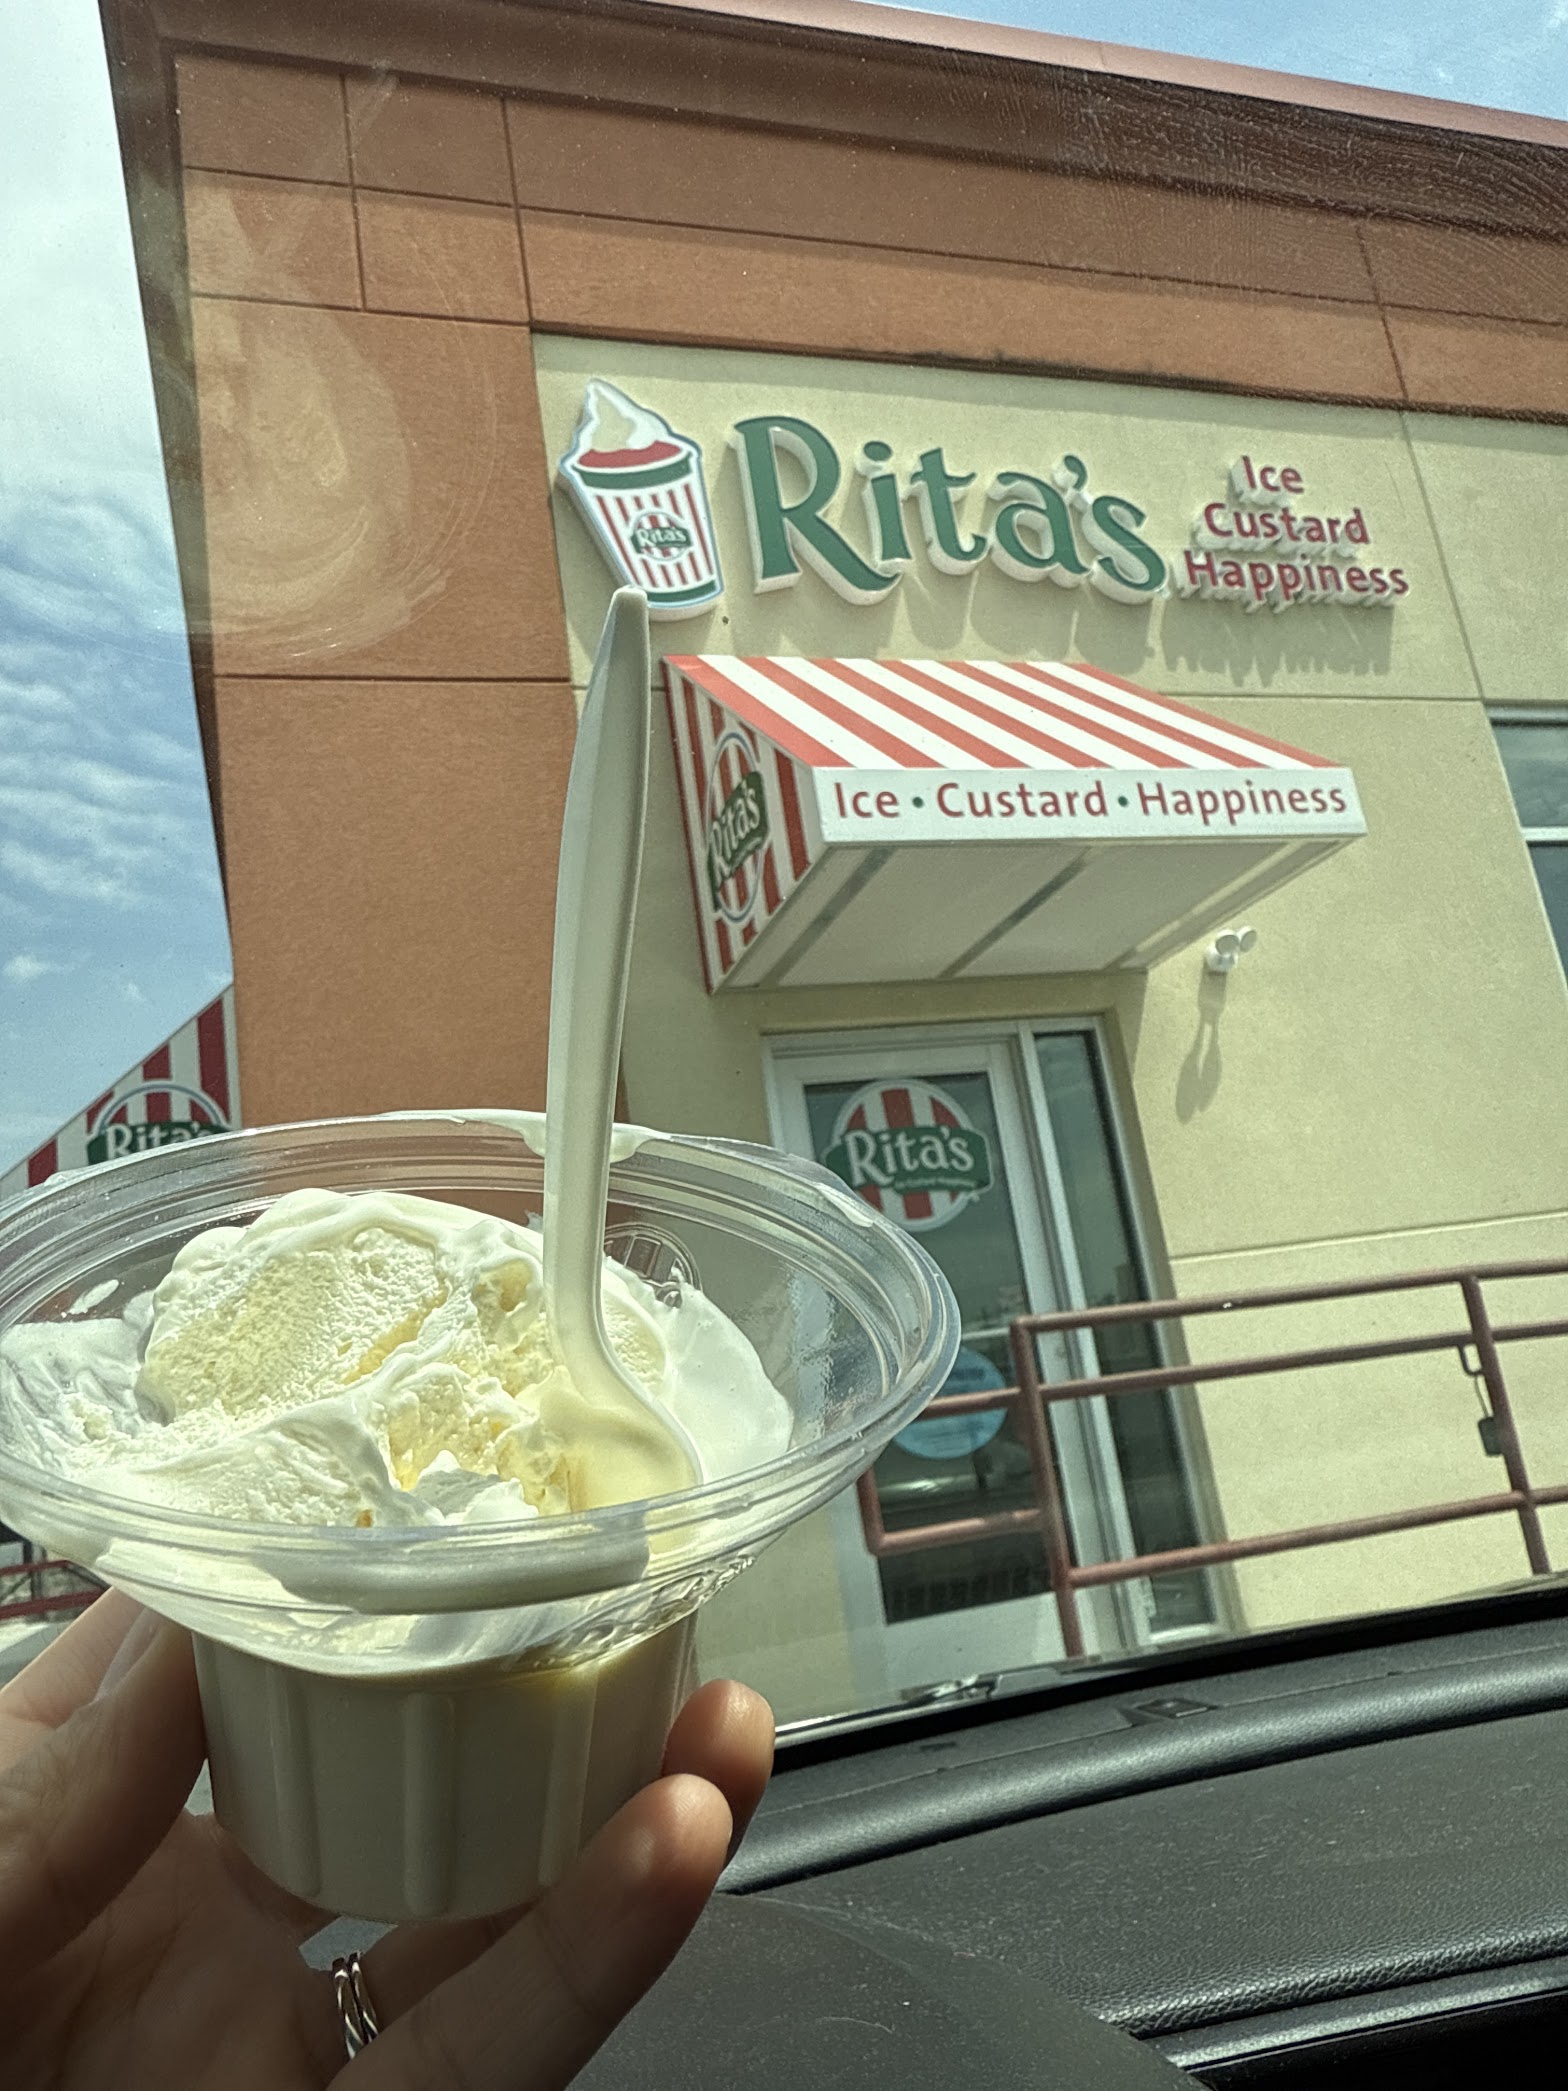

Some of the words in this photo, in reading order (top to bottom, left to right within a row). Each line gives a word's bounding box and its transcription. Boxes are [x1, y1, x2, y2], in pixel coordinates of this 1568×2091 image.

[1240, 454, 1305, 494] Ice
[732, 415, 1168, 593] Rita's
[1203, 502, 1372, 545] Custard
[1183, 550, 1410, 601] Happiness
[833, 781, 901, 819] Ice
[936, 779, 1110, 819] Custard
[1136, 778, 1348, 827] Happiness
[708, 777, 761, 887] Rita's
[844, 1126, 975, 1188] Rita's
